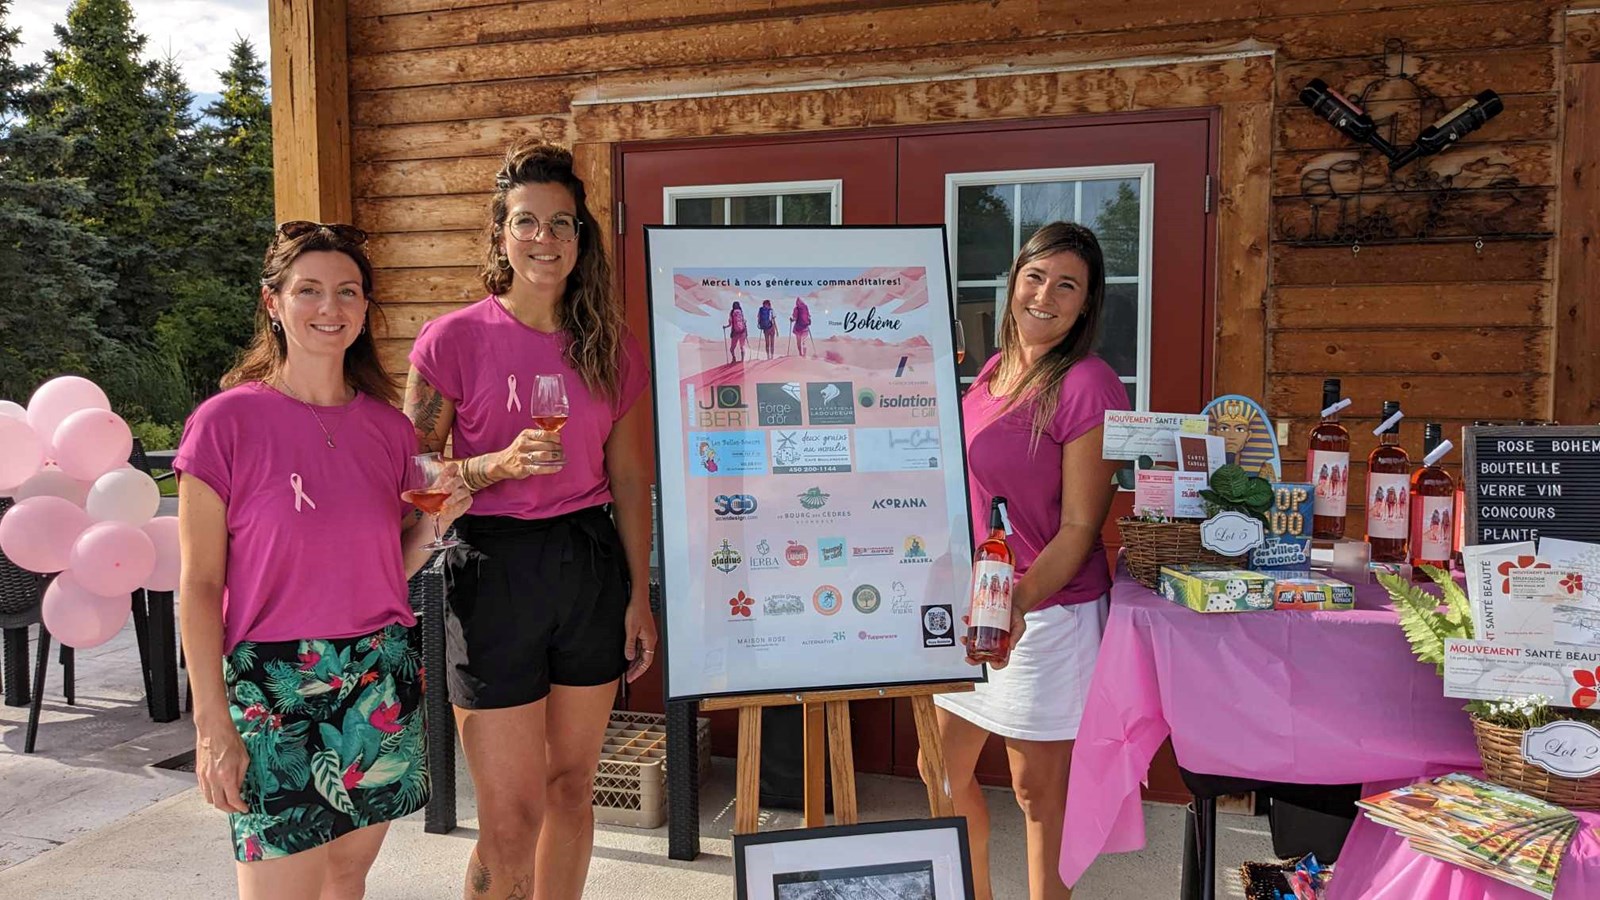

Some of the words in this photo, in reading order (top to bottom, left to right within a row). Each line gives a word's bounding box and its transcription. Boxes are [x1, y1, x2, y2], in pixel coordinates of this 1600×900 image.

[701, 278, 730, 287] Merci
[734, 277, 740, 287] à
[766, 277, 813, 288] généreux
[817, 277, 901, 287] commanditaires!
[844, 306, 902, 333] Bohème
[879, 394, 937, 408] isolation
[759, 402, 791, 416] Forge
[700, 410, 750, 427] BERT
[766, 413, 787, 425] d'or
[1108, 415, 1153, 424] MOUVEMENT
[801, 431, 820, 443] deux
[823, 432, 848, 445] grains
[818, 441, 848, 452] moulin
[1497, 440, 1534, 452] ROSE
[1481, 462, 1560, 474] BOUTEILLE
[1480, 484, 1526, 496] VERRE
[1537, 484, 1562, 496] VIN
[872, 498, 927, 509] ACORANA
[1274, 487, 1308, 511] OP
[1481, 507, 1556, 519] CONCOURS
[1213, 528, 1237, 542] Lot
[1238, 528, 1249, 540] 5
[1483, 528, 1538, 541] PLANTE
[1255, 549, 1270, 557] des
[1270, 545, 1300, 555] villes
[711, 556, 742, 567] gladius
[1255, 557, 1266, 565] du
[1267, 552, 1304, 565] monde
[1481, 560, 1493, 597] BEAUTÉ
[1482, 600, 1495, 629] SANTÉ
[737, 637, 765, 645] MAISON
[1449, 644, 1521, 657] MOUVEMENT
[1525, 648, 1562, 659] SANTÉ
[1542, 739, 1577, 758] Lot
[1584, 746, 1599, 760] 2
